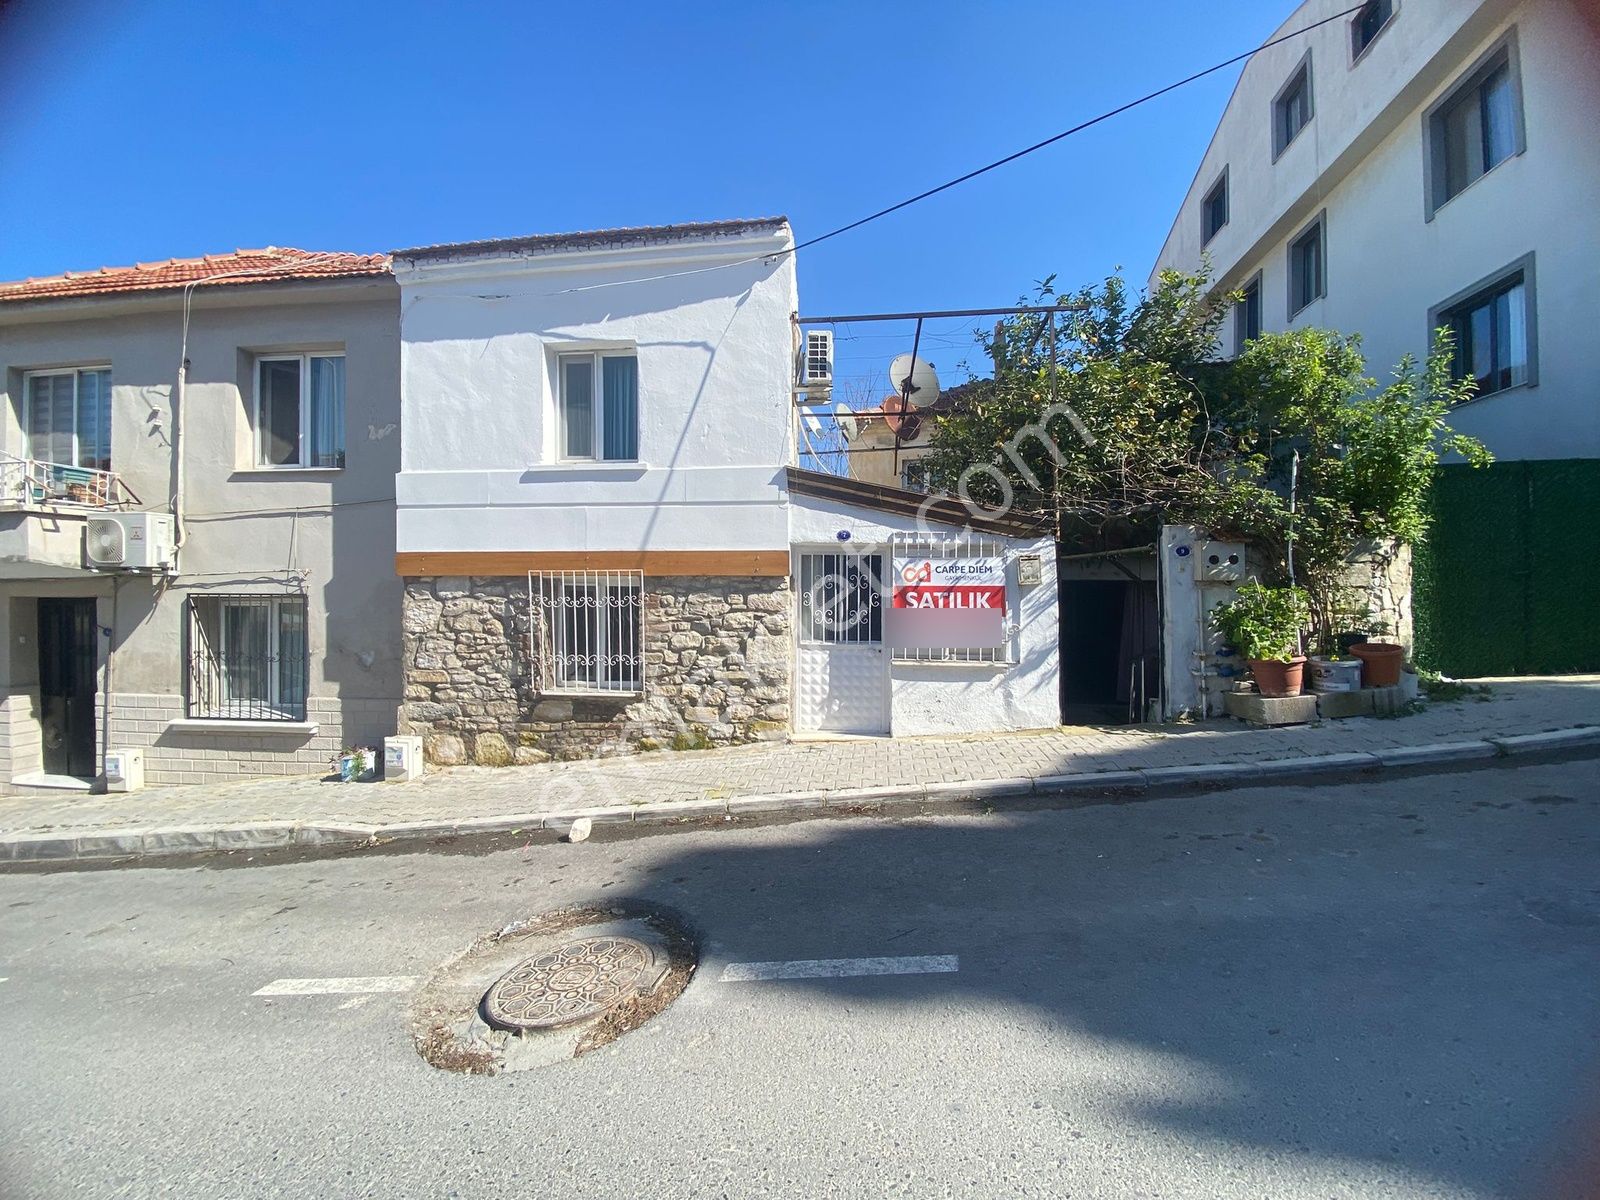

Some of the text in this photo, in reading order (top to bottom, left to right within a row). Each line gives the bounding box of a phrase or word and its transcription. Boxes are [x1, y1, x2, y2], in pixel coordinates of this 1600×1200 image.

[935, 565, 993, 574] CARPE DIEM
[905, 591, 992, 608] SATILIK
